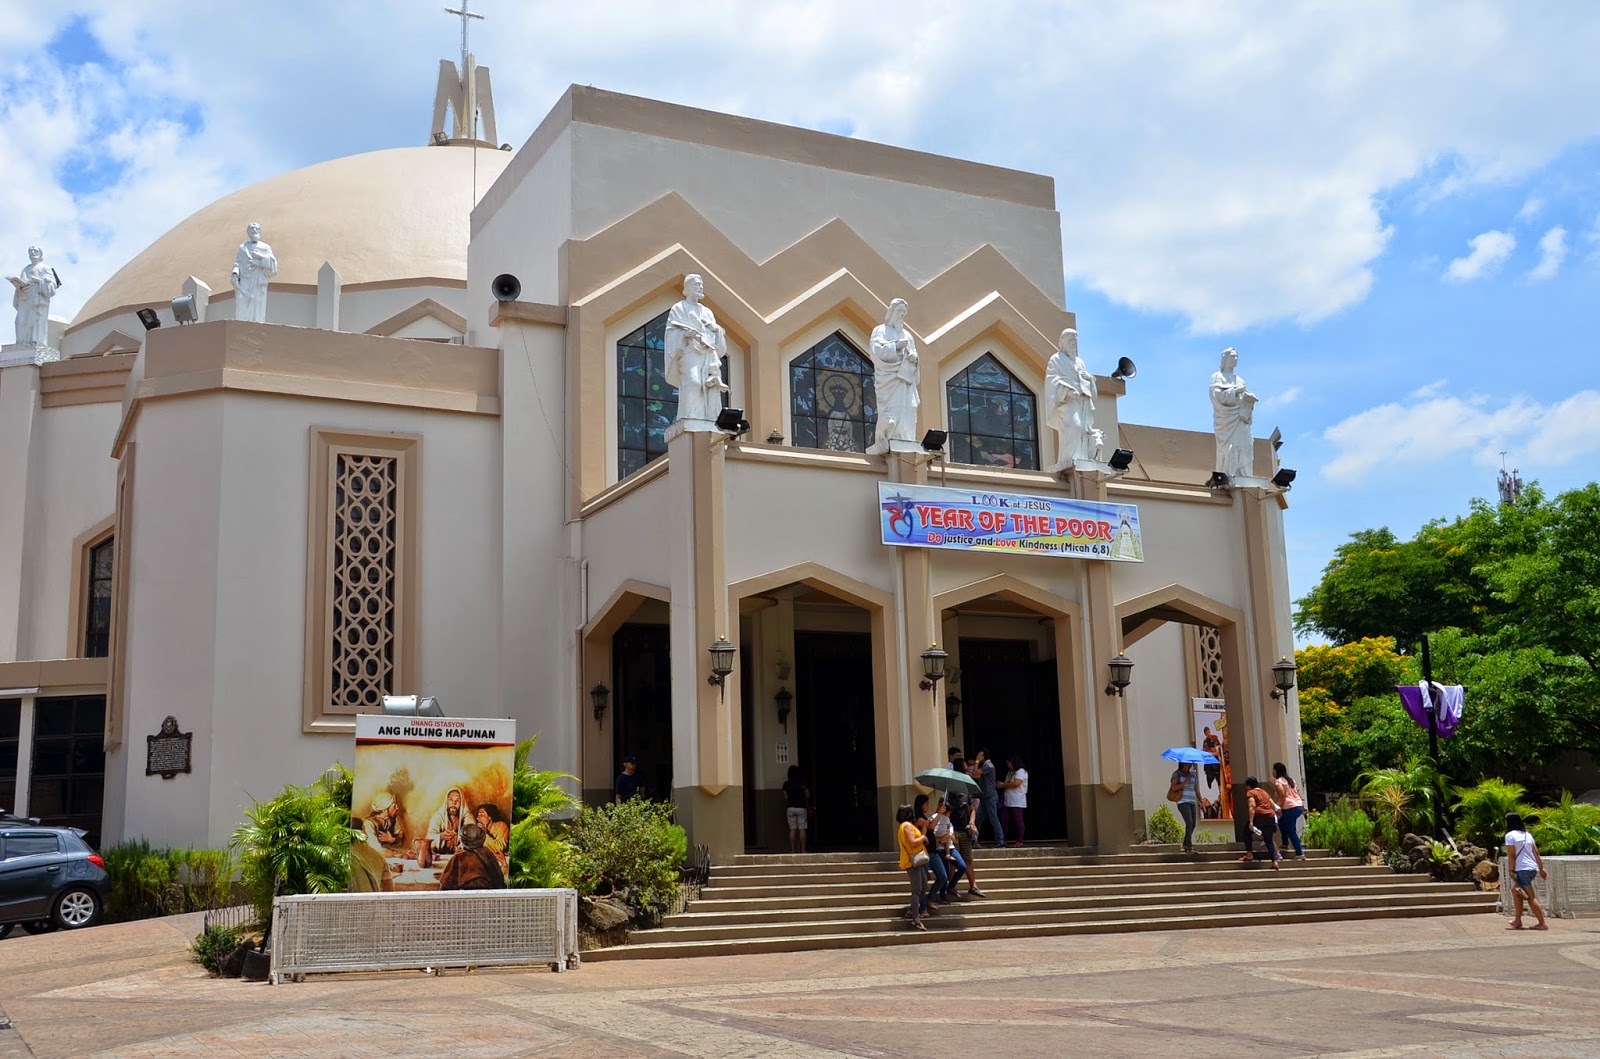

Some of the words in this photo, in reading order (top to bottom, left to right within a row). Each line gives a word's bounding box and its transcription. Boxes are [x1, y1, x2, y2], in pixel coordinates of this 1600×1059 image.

[1024, 501, 1051, 511] JESUS
[916, 505, 975, 531] YEAR
[978, 511, 1005, 533] OF
[1010, 513, 1051, 535] THE
[1055, 518, 1113, 541] POOR
[928, 532, 942, 543] Do
[944, 534, 973, 544] justice
[976, 537, 993, 546] and
[996, 539, 1016, 548] Love
[1019, 539, 1058, 550] Kindness
[1061, 543, 1090, 553] (Micah
[378, 726, 401, 735] ANG
[404, 727, 443, 737] HULING
[446, 729, 495, 739] HAPUNAN
